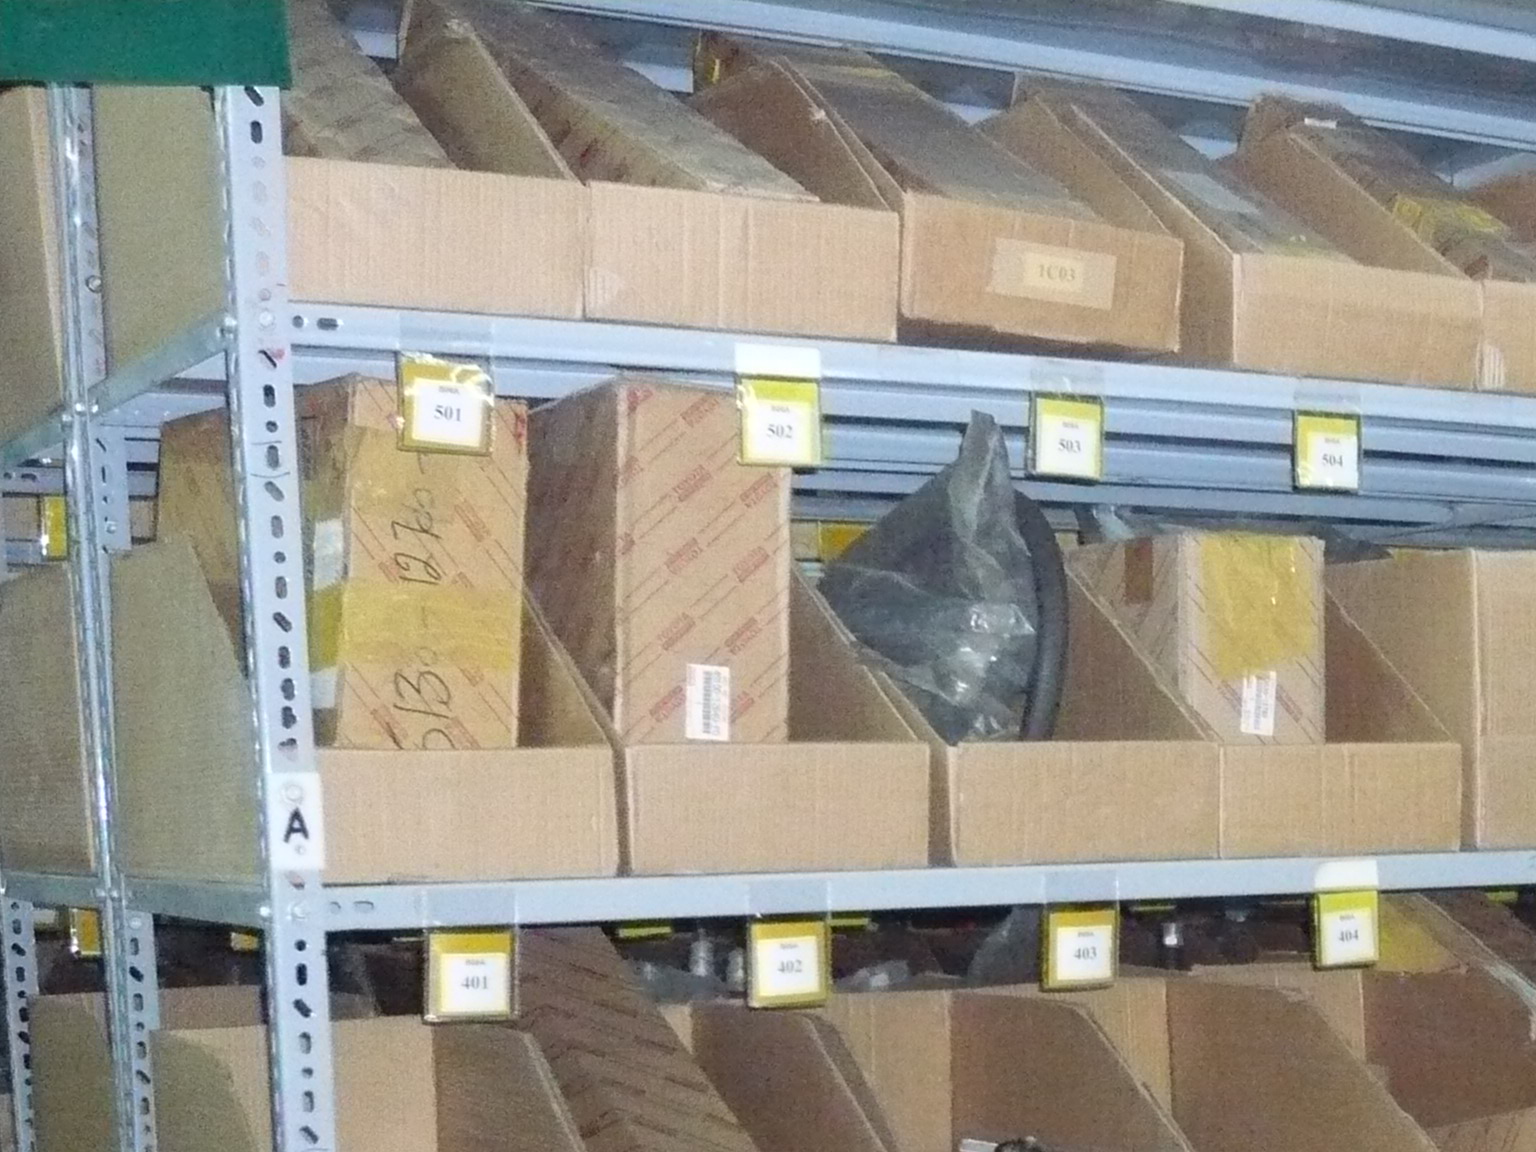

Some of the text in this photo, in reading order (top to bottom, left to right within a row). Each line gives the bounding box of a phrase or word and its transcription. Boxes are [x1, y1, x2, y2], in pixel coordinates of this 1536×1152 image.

[434, 405, 463, 424] 501
[766, 422, 795, 440] 502
[1057, 434, 1083, 453] 503
[1321, 452, 1345, 468] 504
[284, 808, 310, 842] A
[1338, 928, 1360, 945] 404
[1073, 945, 1098, 962] 403
[777, 957, 803, 975] 402
[461, 973, 489, 991] 401
